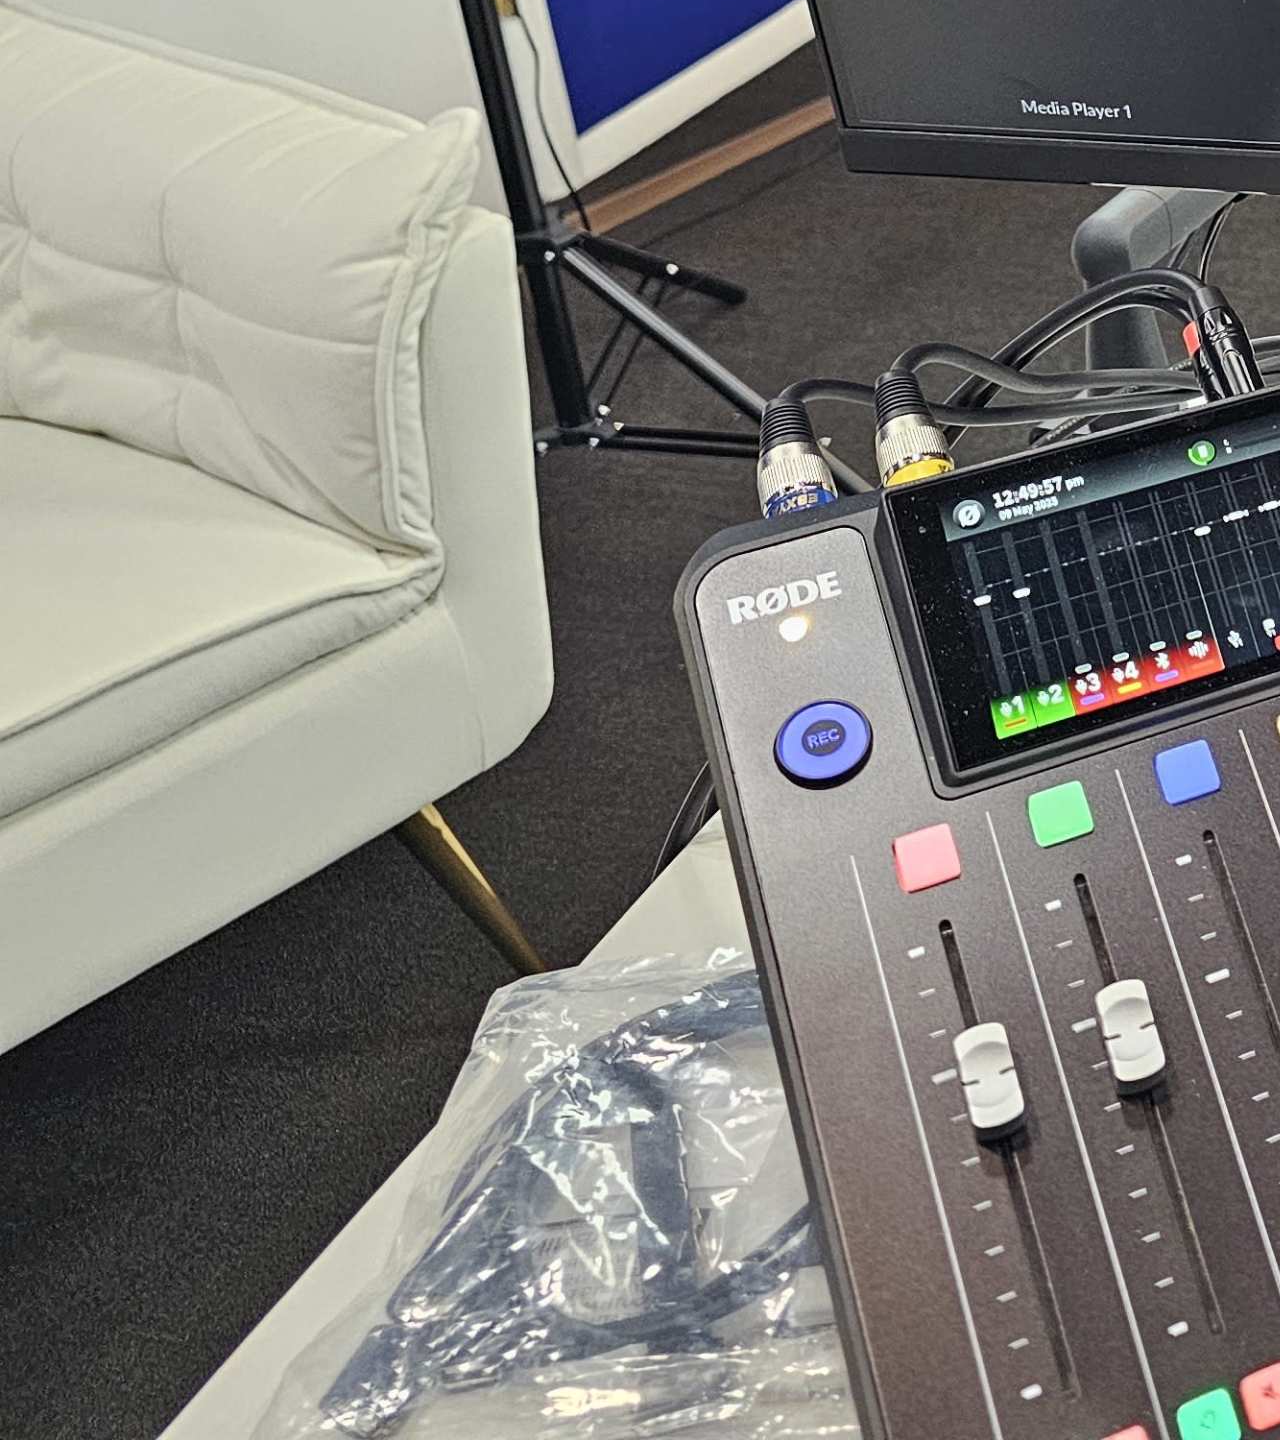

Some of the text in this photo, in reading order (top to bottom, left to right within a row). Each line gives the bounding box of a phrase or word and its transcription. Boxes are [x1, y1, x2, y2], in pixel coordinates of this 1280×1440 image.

[1022, 99, 1131, 121] Media Player 1
[992, 476, 1084, 508] 12:49:57 pm
[727, 572, 842, 625] RØDE
[807, 728, 840, 749] REC
